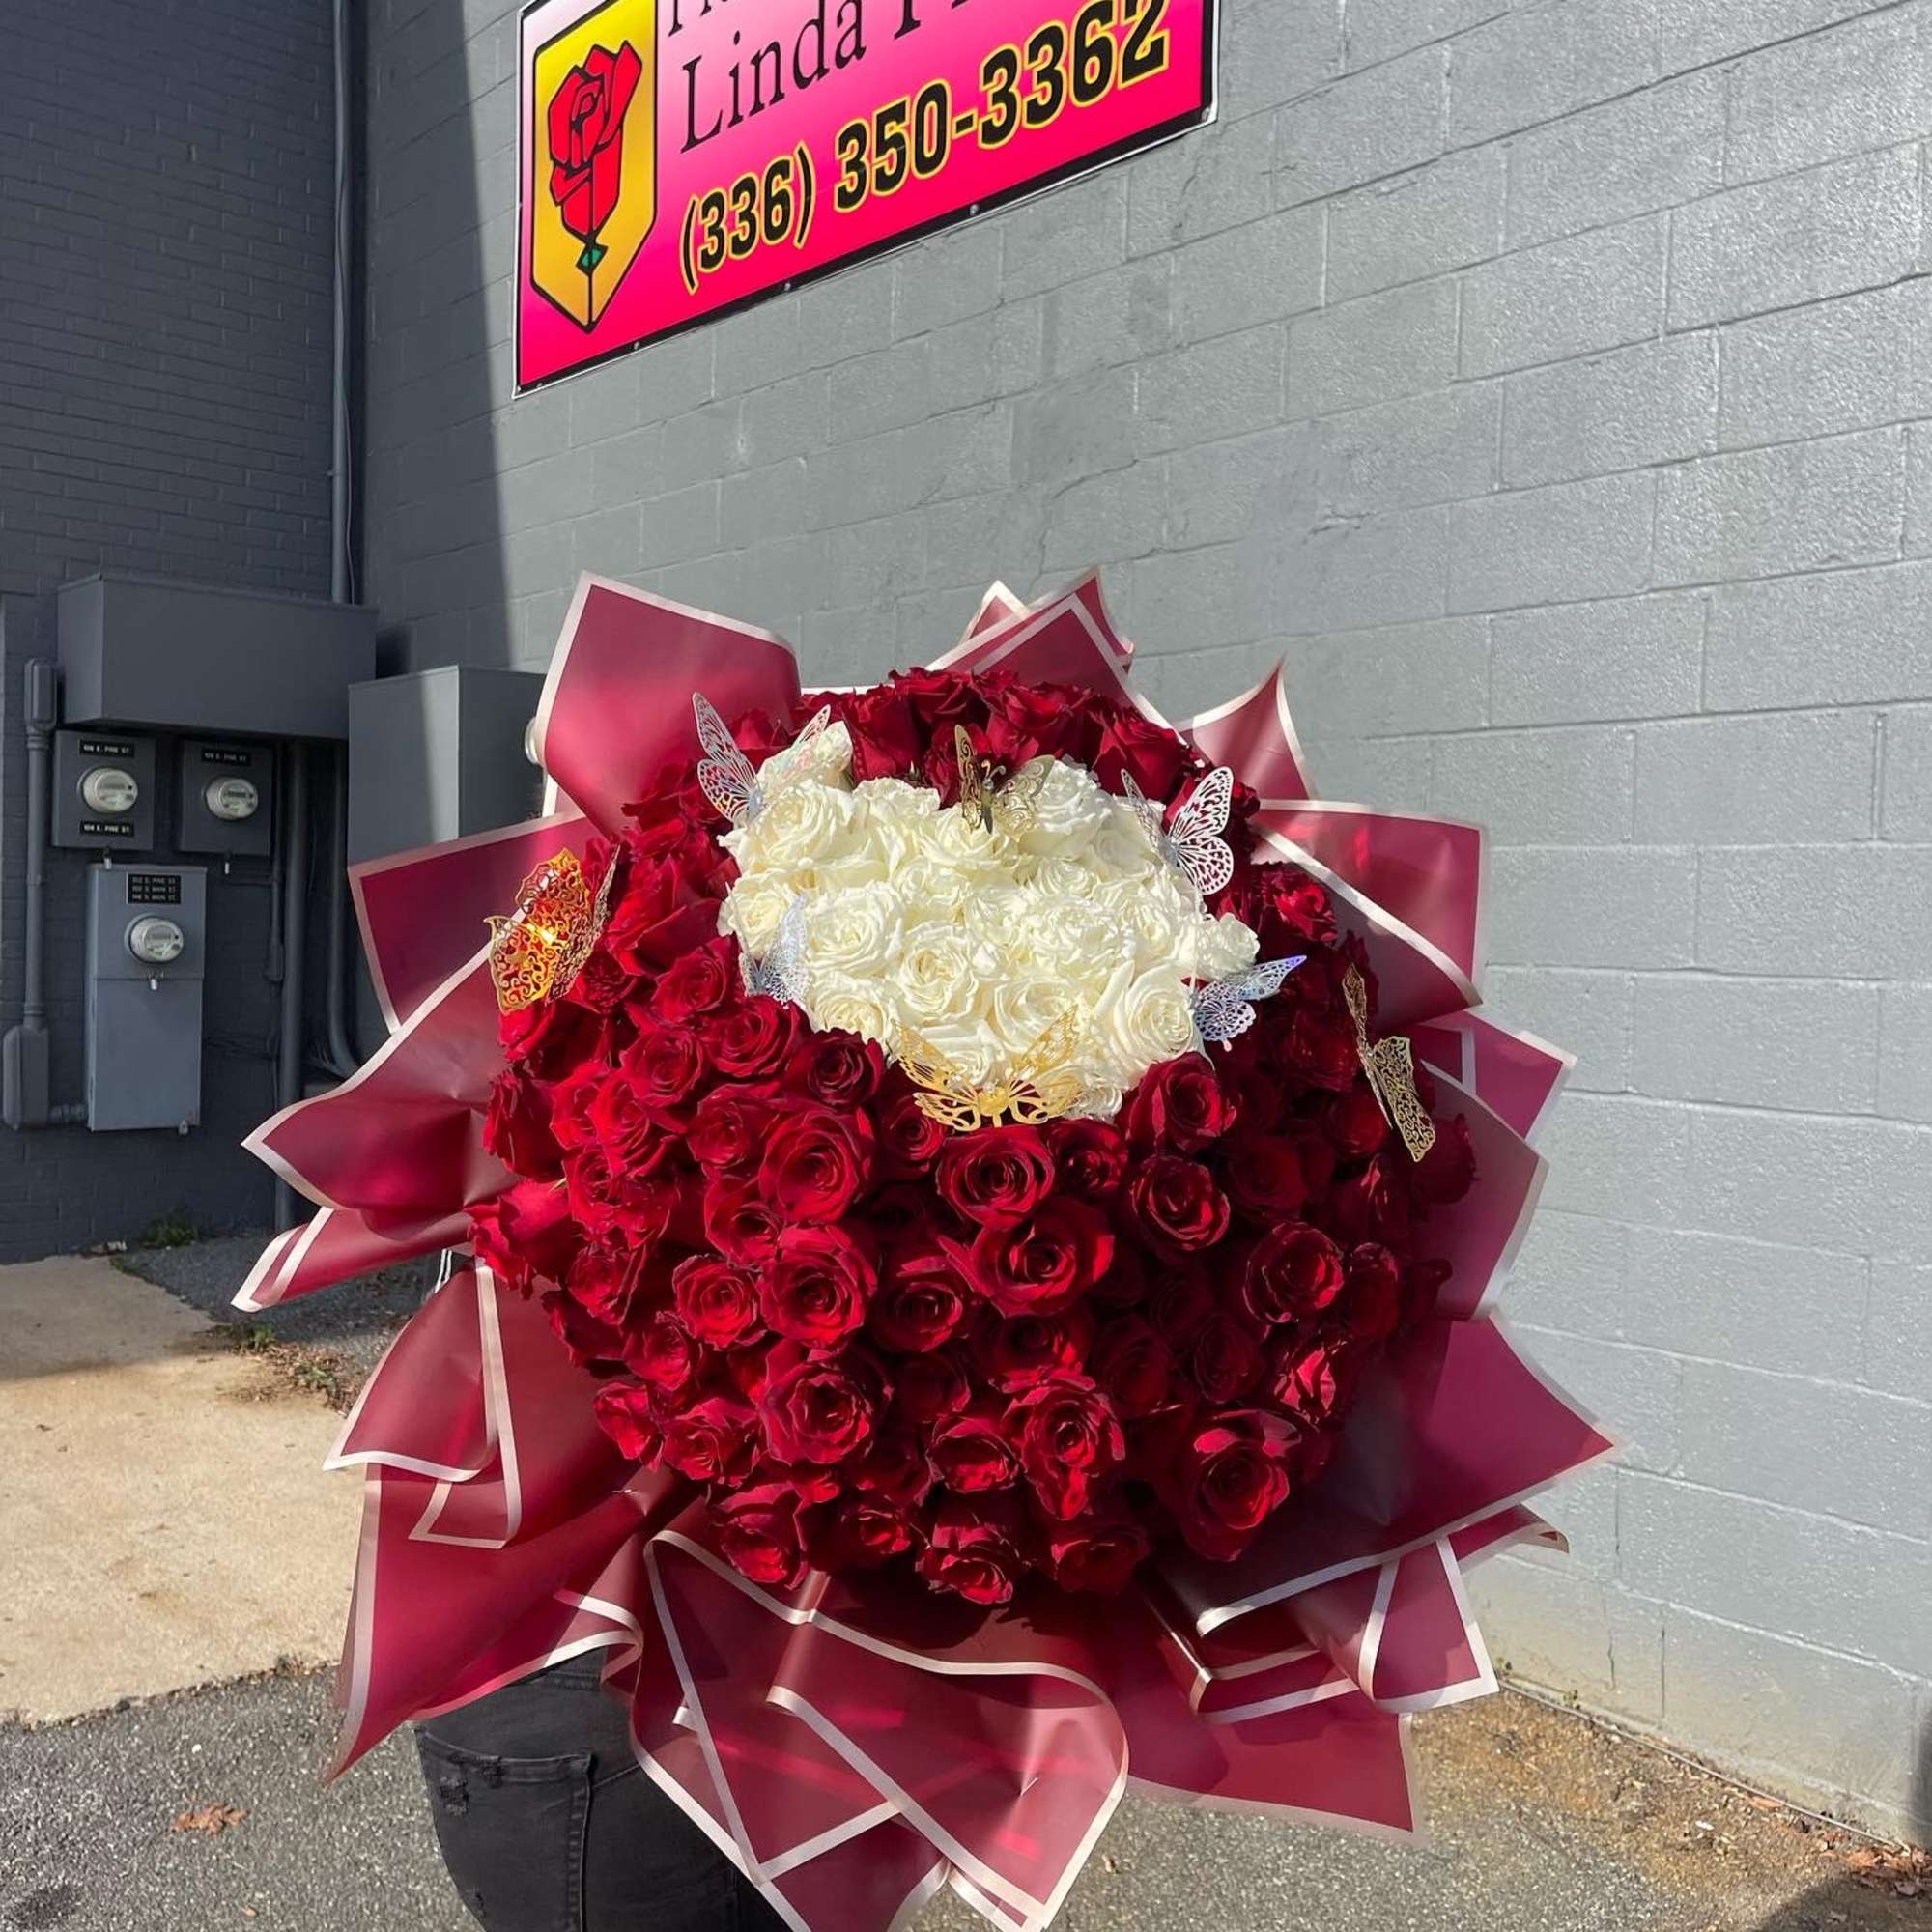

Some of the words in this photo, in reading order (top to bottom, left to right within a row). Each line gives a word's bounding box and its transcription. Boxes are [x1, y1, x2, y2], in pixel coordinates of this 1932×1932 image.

[680, 0, 866, 154] Linda
[680, 140, 816, 295] (336)
[835, 0, 1170, 213] 350-3362
